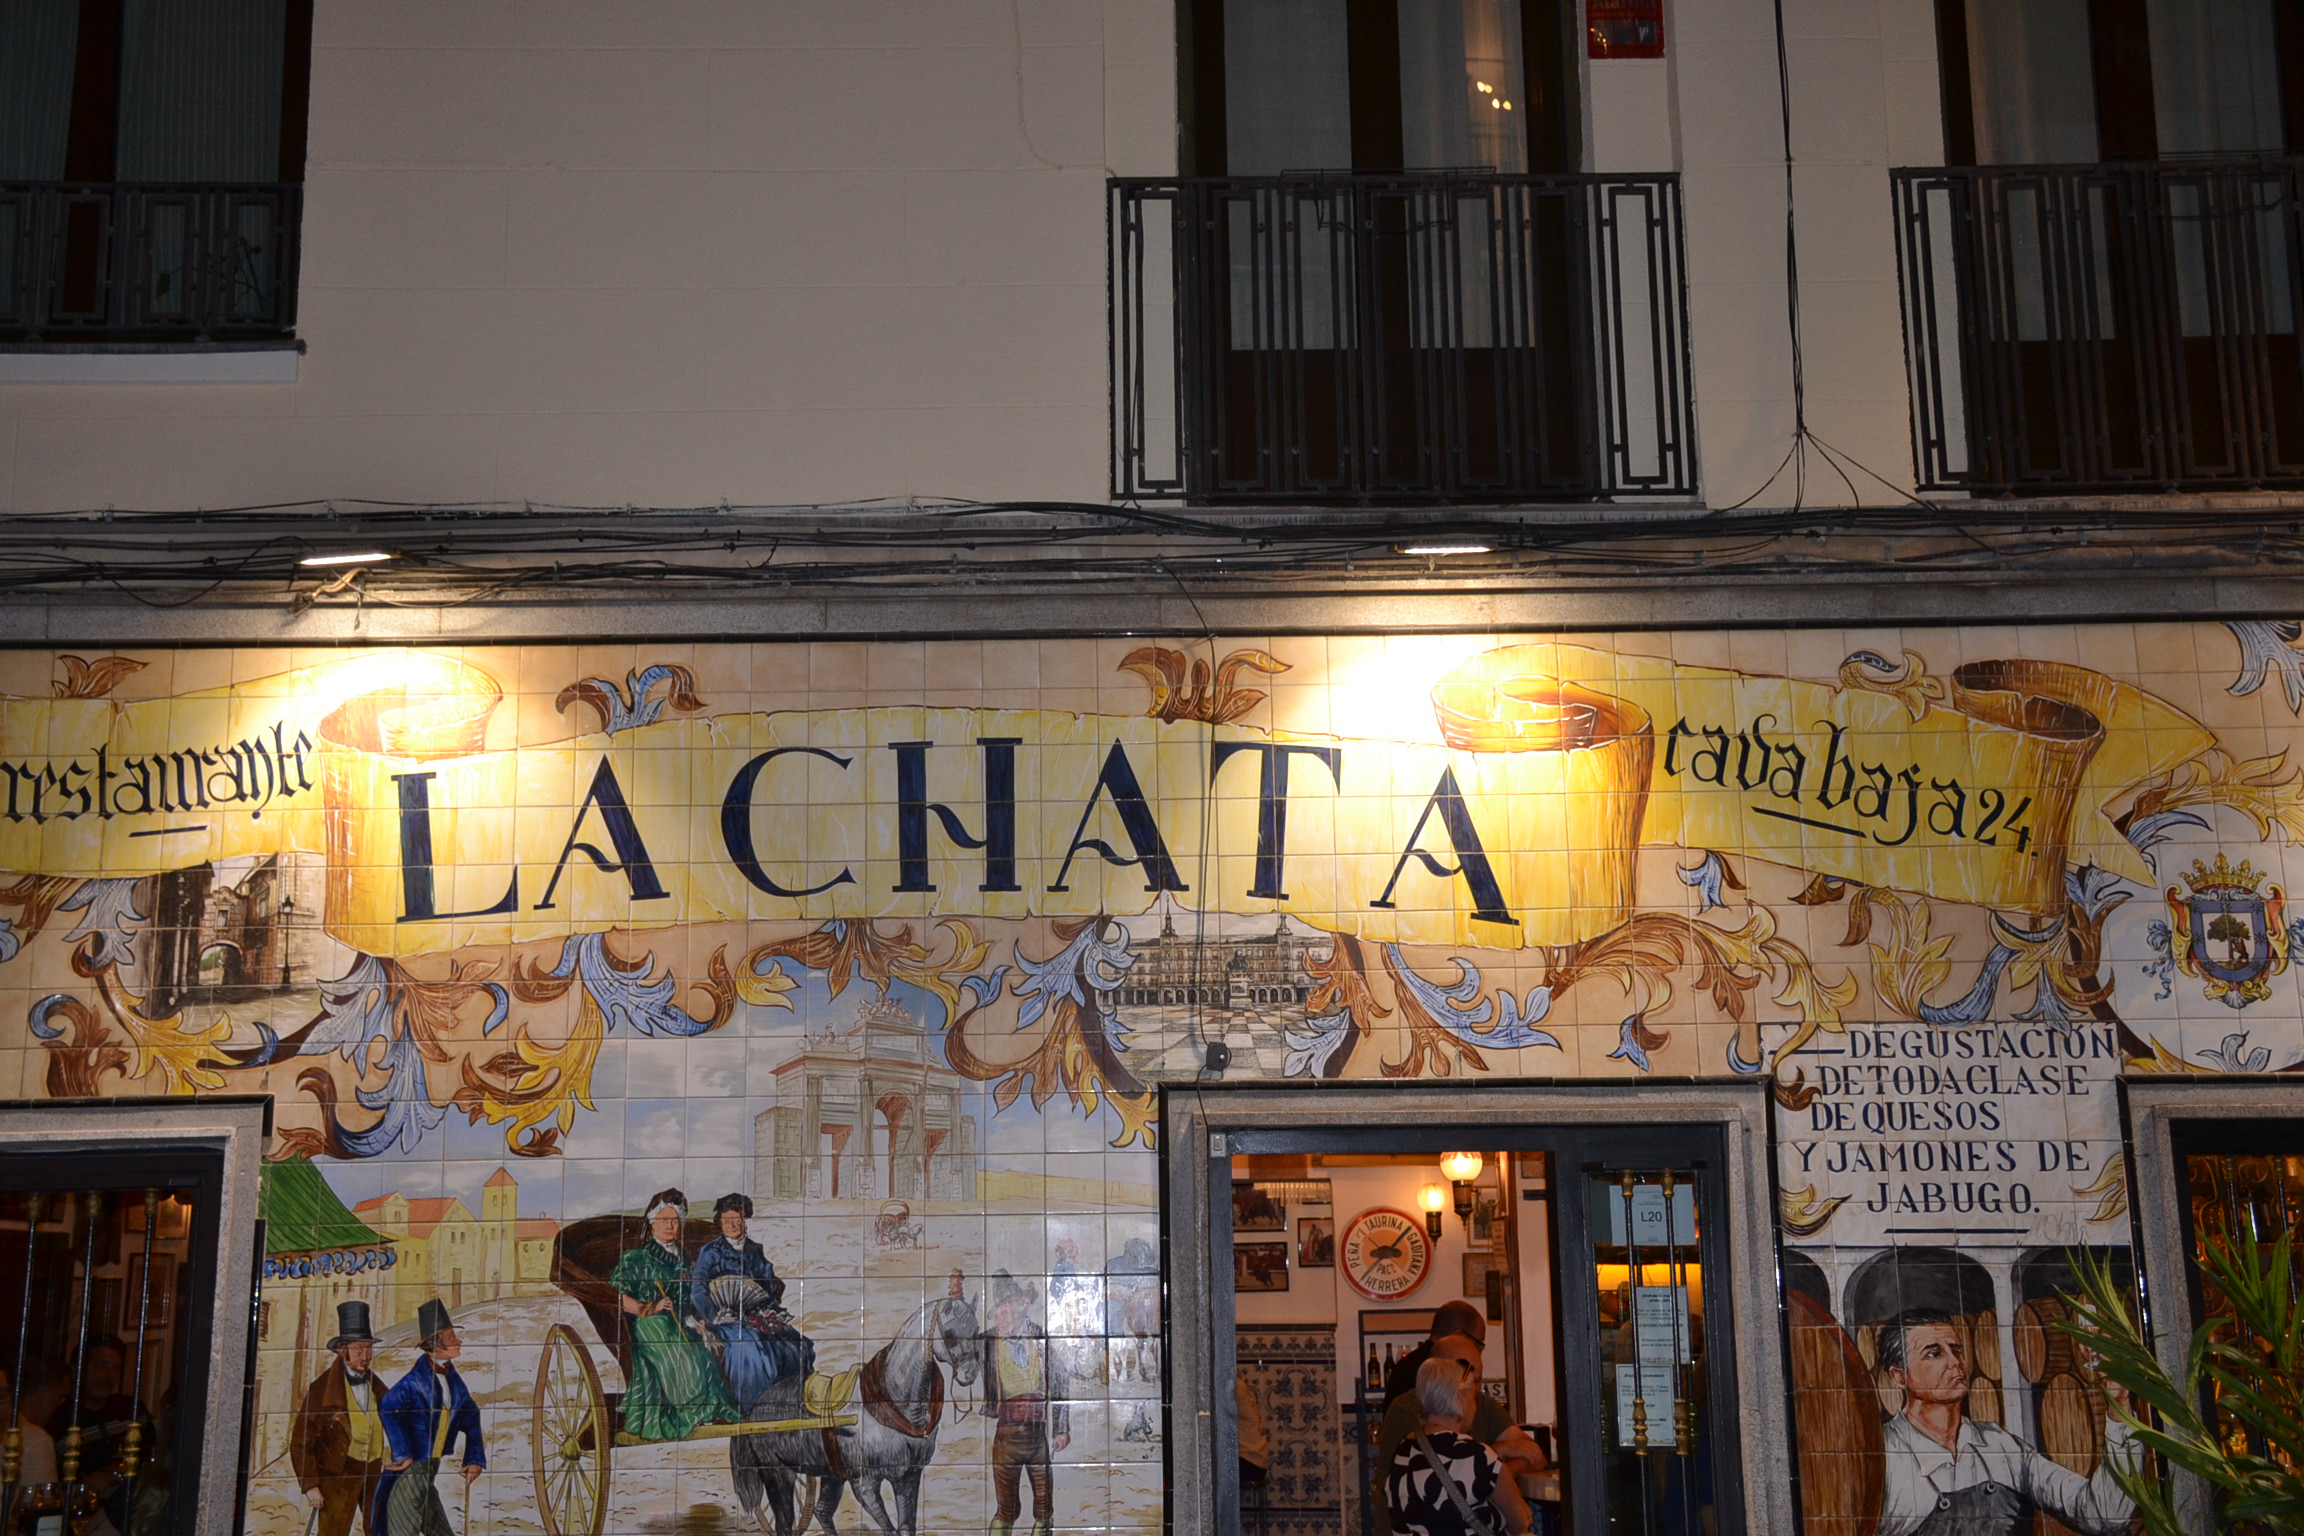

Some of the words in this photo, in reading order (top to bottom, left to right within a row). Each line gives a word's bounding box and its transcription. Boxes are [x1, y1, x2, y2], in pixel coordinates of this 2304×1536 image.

[0, 720, 313, 825] restaurante
[390, 753, 671, 923] LA
[721, 736, 1520, 926] CHATA
[1849, 1025, 2116, 1060] DEGUSTACIÓN
[1818, 1065, 1865, 1096] DE
[1866, 1065, 1963, 1096] TODA
[1965, 1064, 2090, 1096] CLASE
[1811, 1101, 1857, 1132] DE
[1861, 1100, 2001, 1135] QUESOS
[1792, 1142, 1817, 1173] Y
[1826, 1141, 2018, 1173] JAMONES
[2038, 1141, 2091, 1172] DE
[1866, 1182, 2041, 1214] JABUGO.
[1640, 1211, 1663, 1222] L20
[1347, 1241, 1361, 1269] PEÑA
[1363, 1215, 1404, 1231] TAURINA
[1406, 1232, 1424, 1276] GADITANA
[1365, 1275, 1411, 1292] HERRERA
